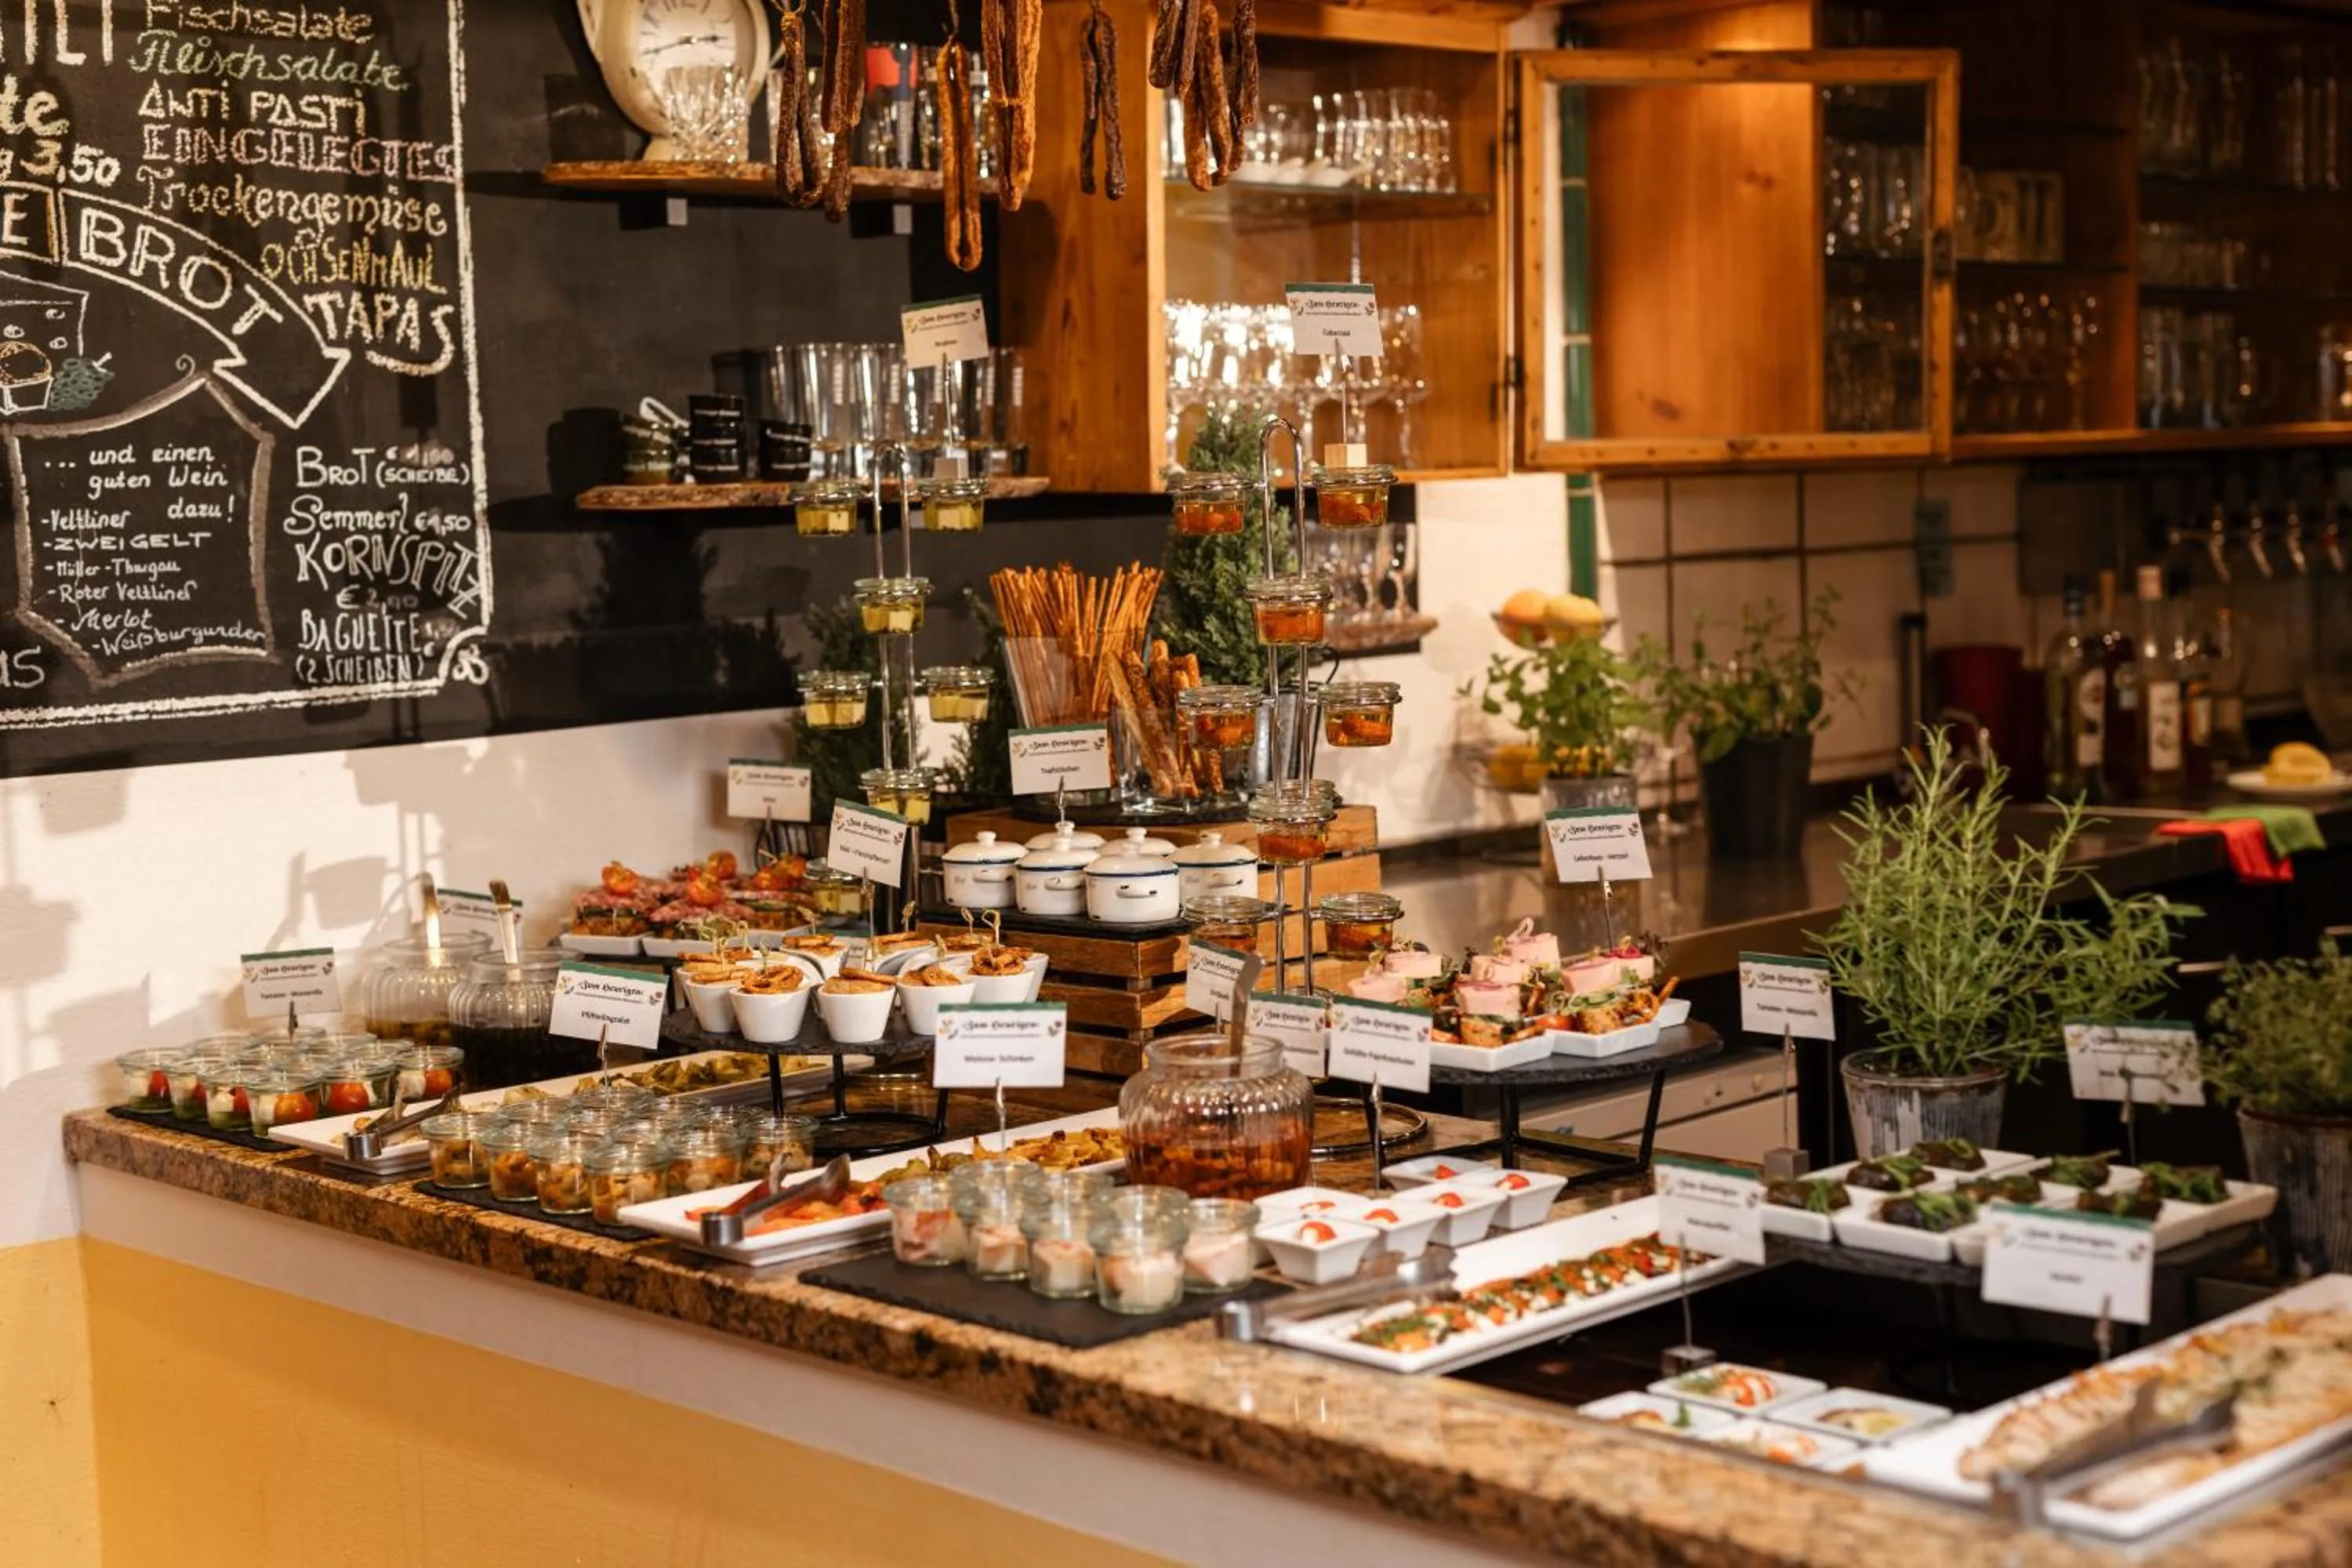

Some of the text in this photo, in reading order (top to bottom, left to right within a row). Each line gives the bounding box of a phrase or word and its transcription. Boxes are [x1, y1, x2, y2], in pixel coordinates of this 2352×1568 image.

[79, 207, 284, 336] BROT
[303, 291, 455, 376] TAPAS
[87, 464, 228, 500] guten Wein
[89, 444, 136, 465] und
[151, 443, 215, 463] einen
